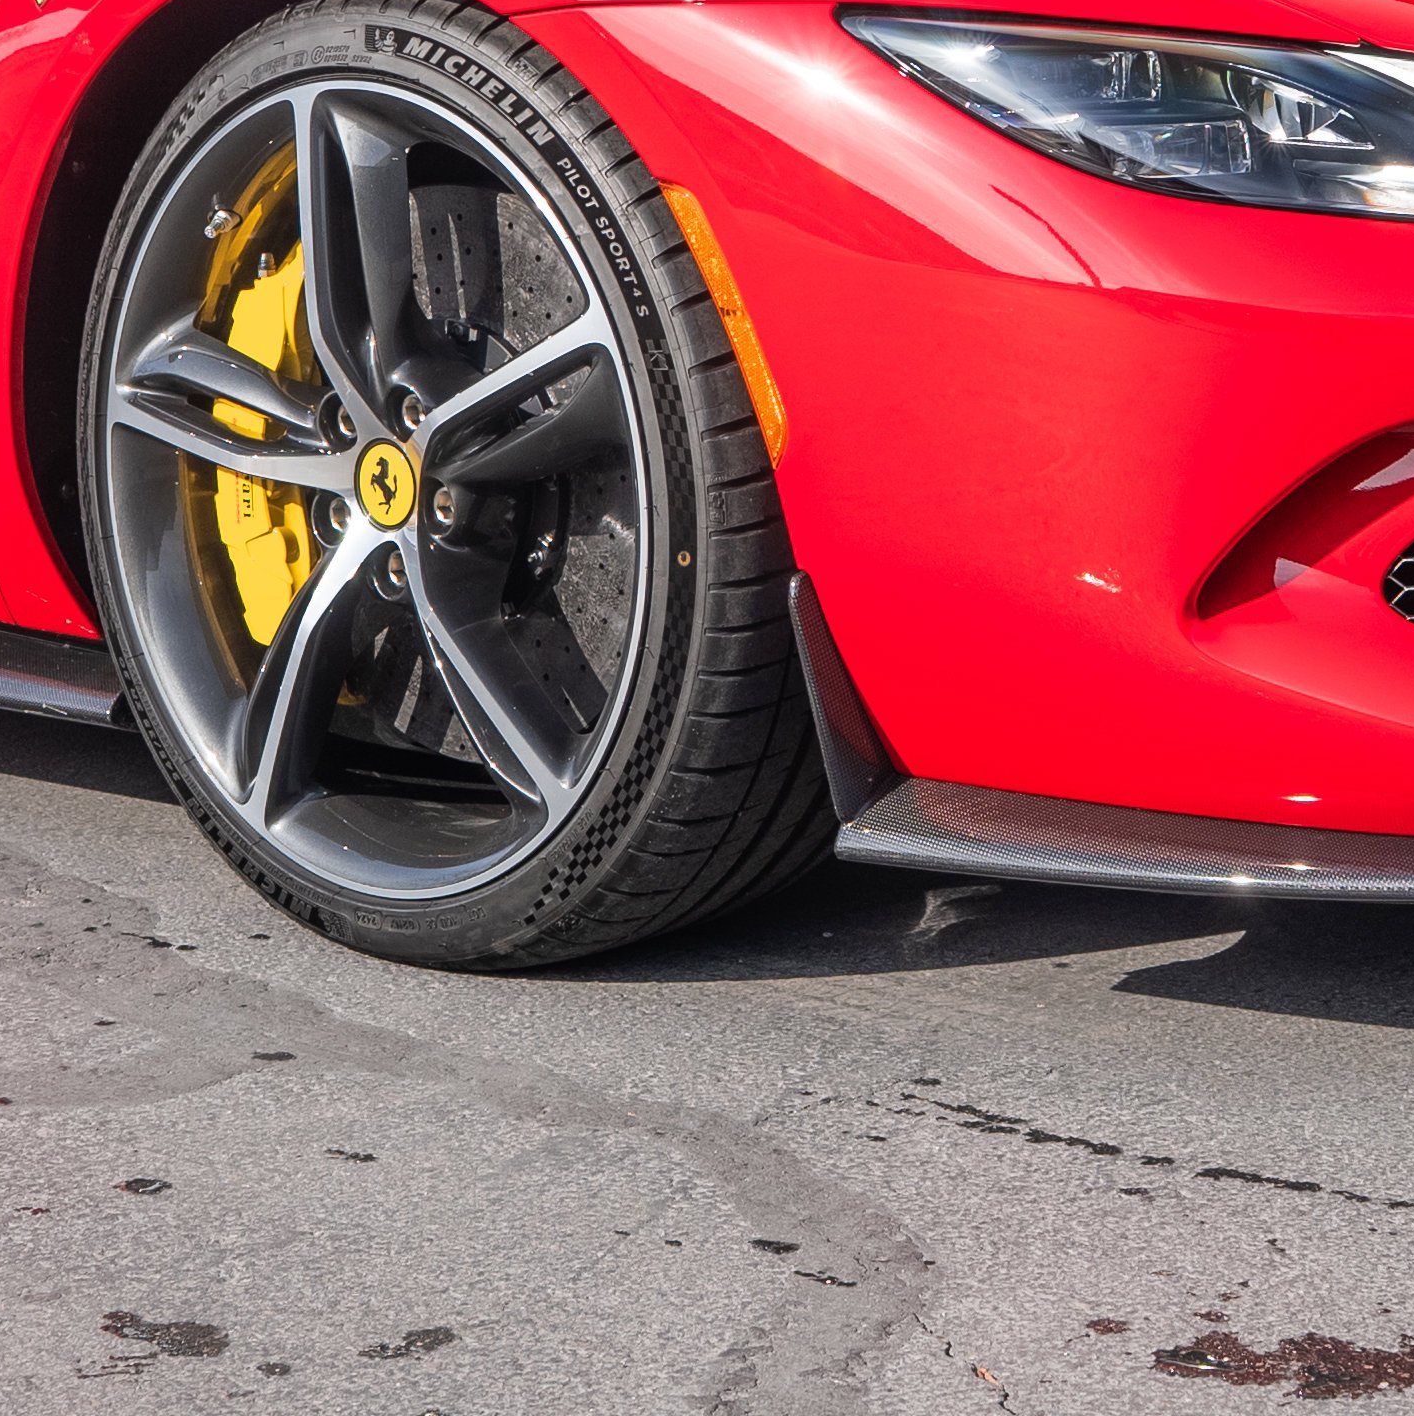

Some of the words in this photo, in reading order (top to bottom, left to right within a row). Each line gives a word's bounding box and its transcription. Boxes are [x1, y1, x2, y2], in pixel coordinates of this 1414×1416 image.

[402, 36, 555, 147] MICHELIN
[556, 157, 600, 209] PILOT
[595, 216, 638, 284] SPORT
[636, 304, 649, 318] S
[187, 797, 312, 921] MICHELIN
